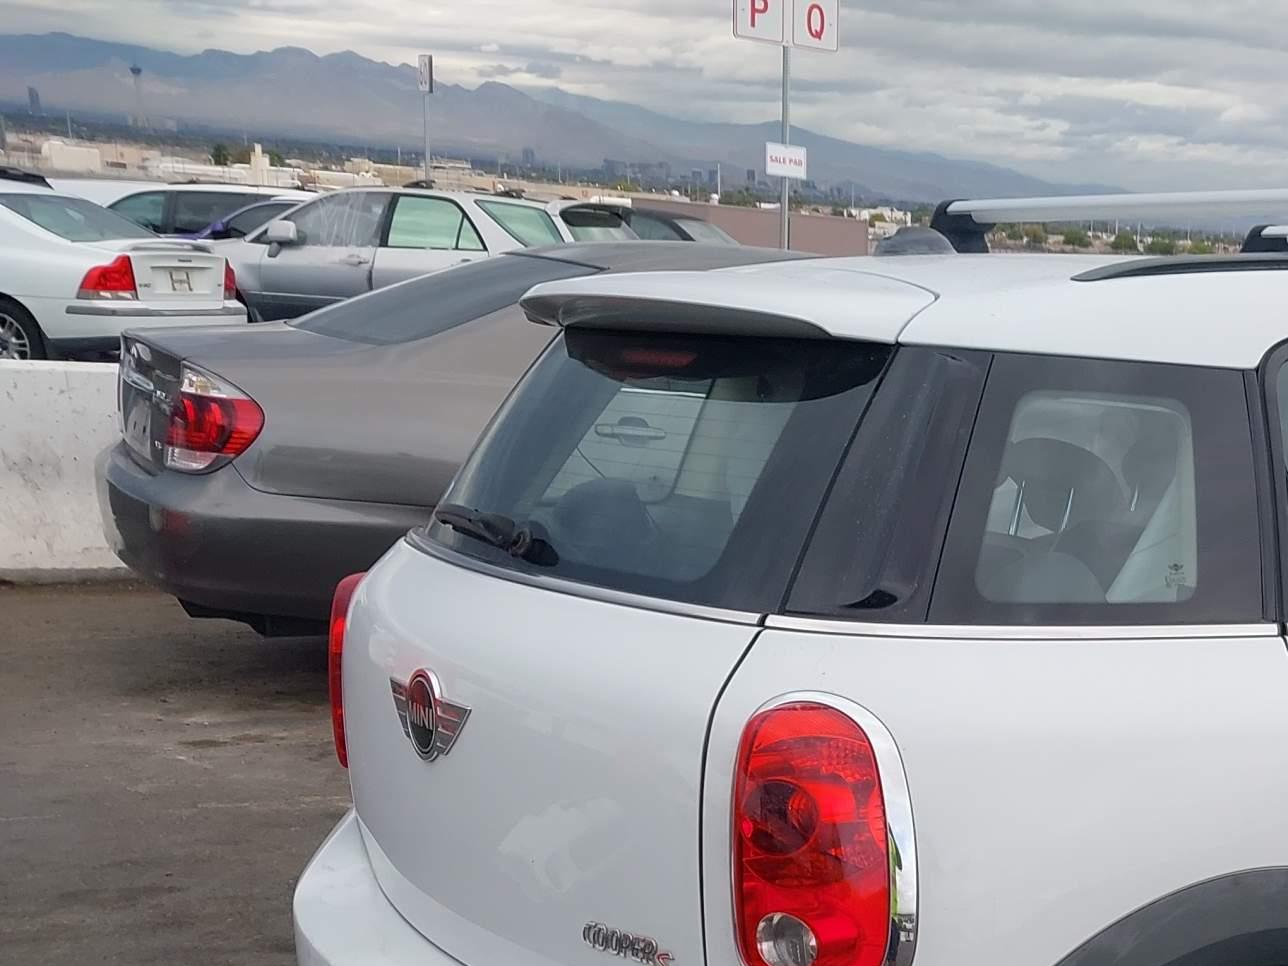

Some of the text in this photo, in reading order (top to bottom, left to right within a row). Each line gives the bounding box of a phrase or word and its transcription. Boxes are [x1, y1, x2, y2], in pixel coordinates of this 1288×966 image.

[749, 0, 769, 28] P
[807, 3, 825, 40] Q
[407, 698, 434, 731] MINI
[582, 920, 659, 966] COOPER
